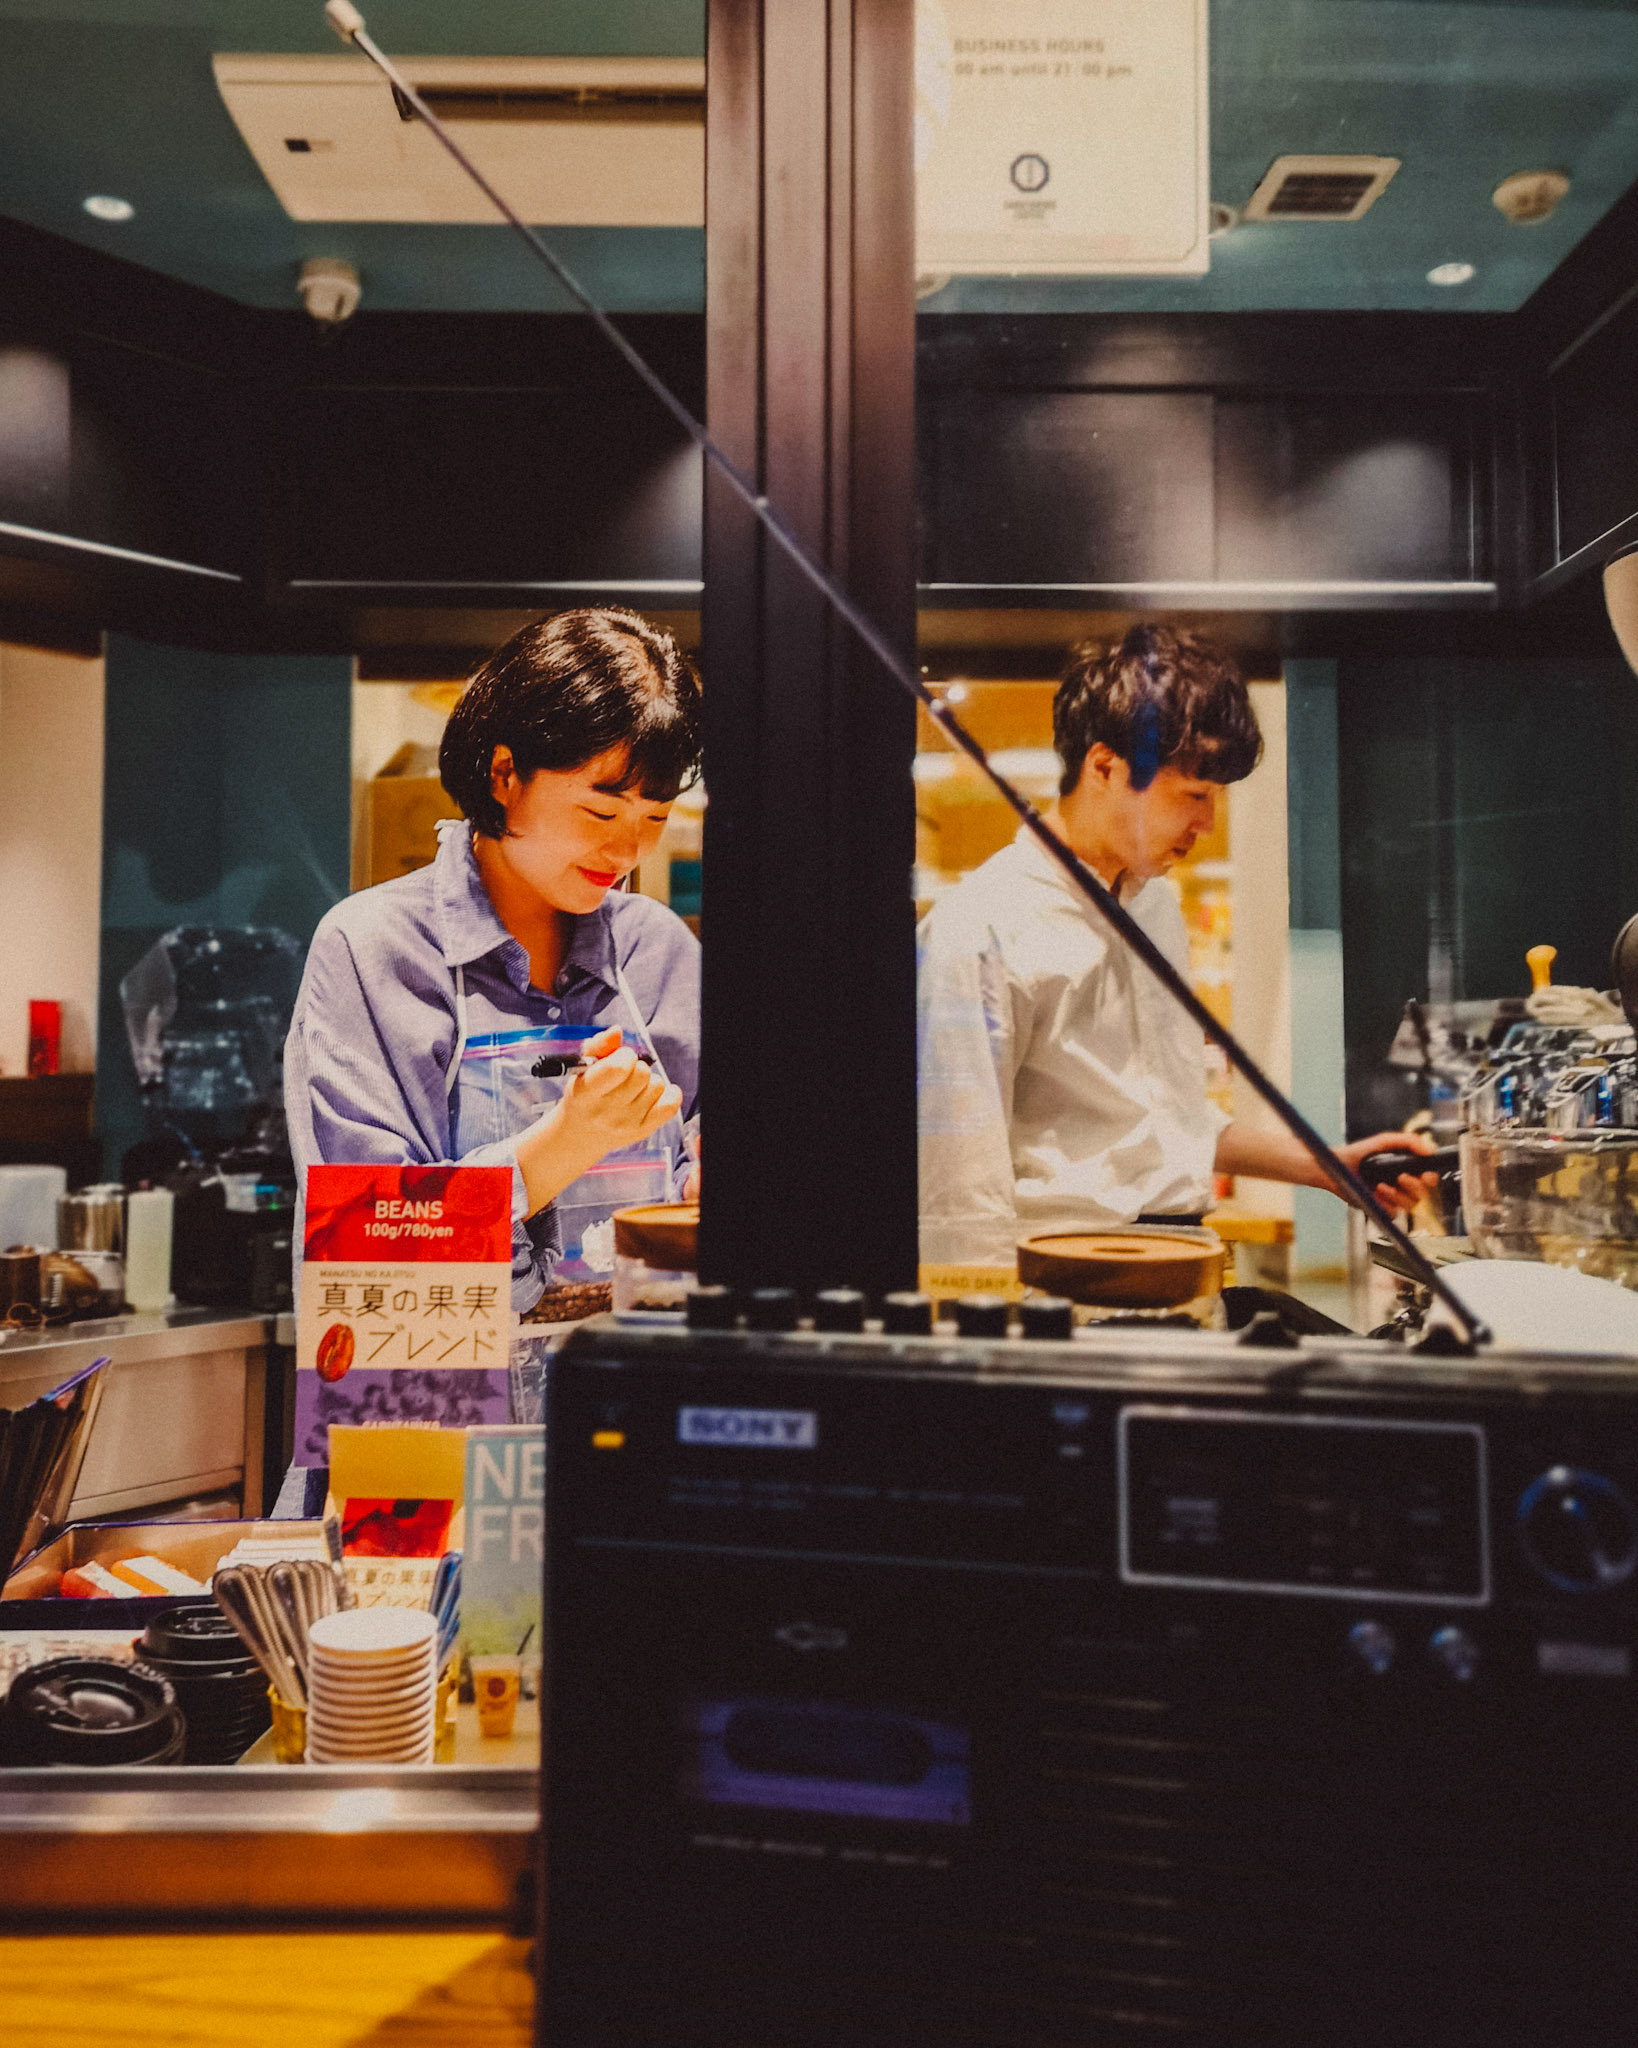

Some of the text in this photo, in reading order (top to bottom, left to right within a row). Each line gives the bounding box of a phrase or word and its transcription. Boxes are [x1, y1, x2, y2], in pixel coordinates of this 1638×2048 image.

[953, 39, 1104, 53] BUSINESS HOURS
[375, 1200, 443, 1219] BEANS
[364, 1222, 454, 1240] 100g/780yen
[317, 1282, 498, 1319] 真夏の果実
[366, 1324, 498, 1361] ブレンド
[692, 1415, 802, 1440] SONY
